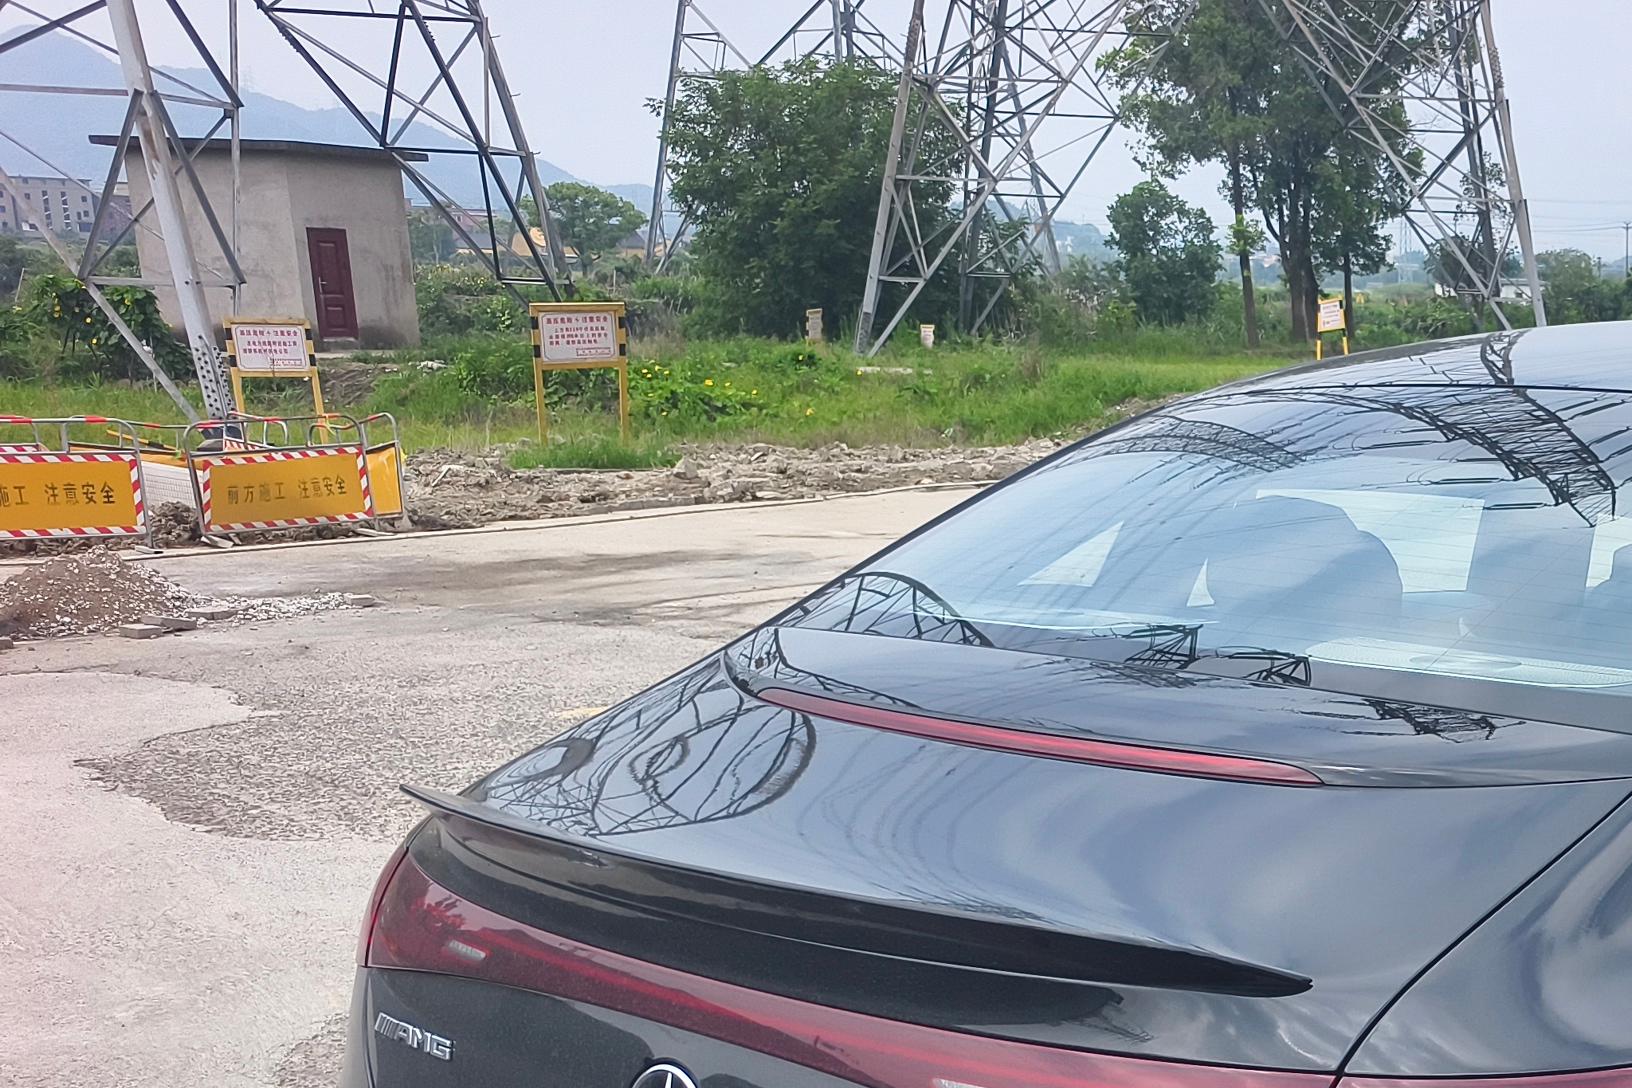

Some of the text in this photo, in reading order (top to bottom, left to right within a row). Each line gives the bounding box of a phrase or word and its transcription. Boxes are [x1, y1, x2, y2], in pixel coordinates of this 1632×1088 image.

[44, 480, 116, 506] 注意安全
[298, 475, 347, 499] 注意安全
[391, 1019, 453, 1061] AMG
